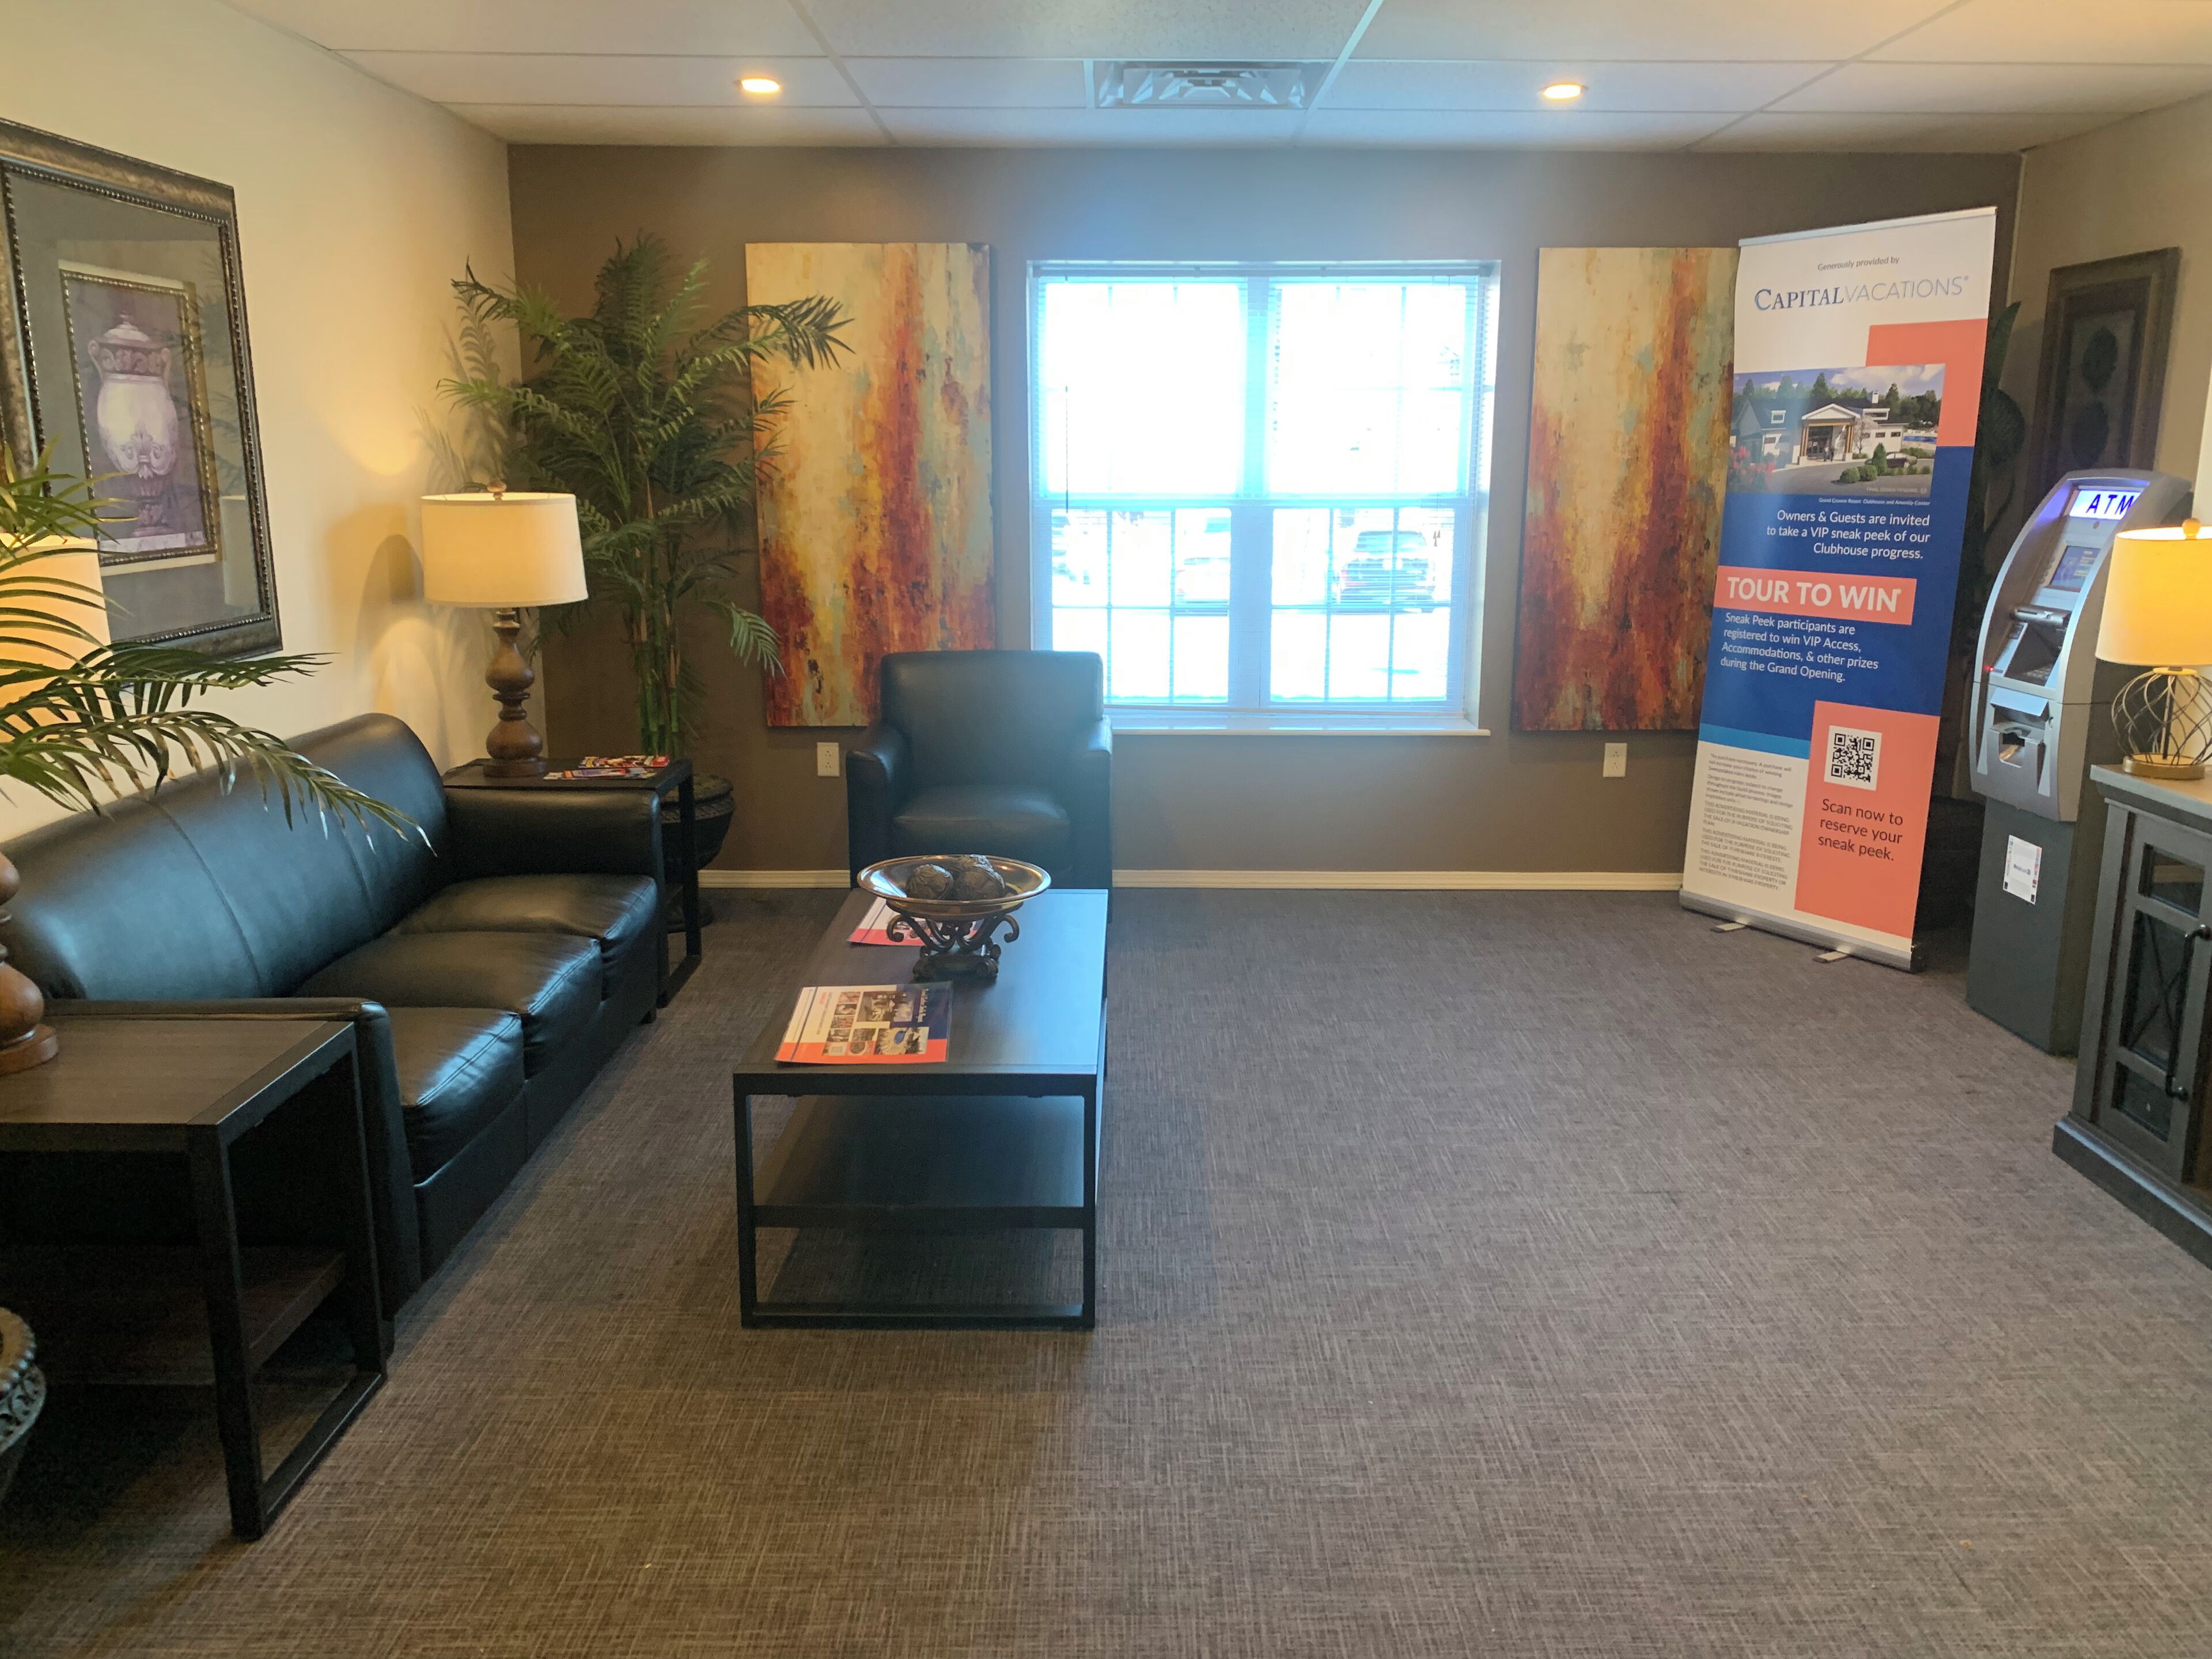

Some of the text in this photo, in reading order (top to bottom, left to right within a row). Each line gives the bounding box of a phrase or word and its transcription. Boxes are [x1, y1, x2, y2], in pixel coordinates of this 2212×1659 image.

[1817, 256, 1900, 272] Generously provided by
[2085, 493, 2135, 515] ATM
[1777, 509, 1930, 527] Owners & Guests are invited
[1766, 525, 1931, 543] to take a VIP sneak peek of our
[1813, 542, 1924, 560] Clubhouse progress.
[1727, 577, 1790, 604] TOUR
[1796, 582, 1832, 607] TO
[1725, 612, 1856, 635] Sneak Peek participants are
[1724, 627, 1861, 653] registered to win VIP Access,
[1721, 641, 1879, 670] Accommodations, & other prizes
[1720, 656, 1846, 684] during the Grand Opening.
[1821, 798, 1903, 825] Scan now to
[1820, 819, 1903, 844] reserve your
[1817, 836, 1895, 861] sneak peek.
